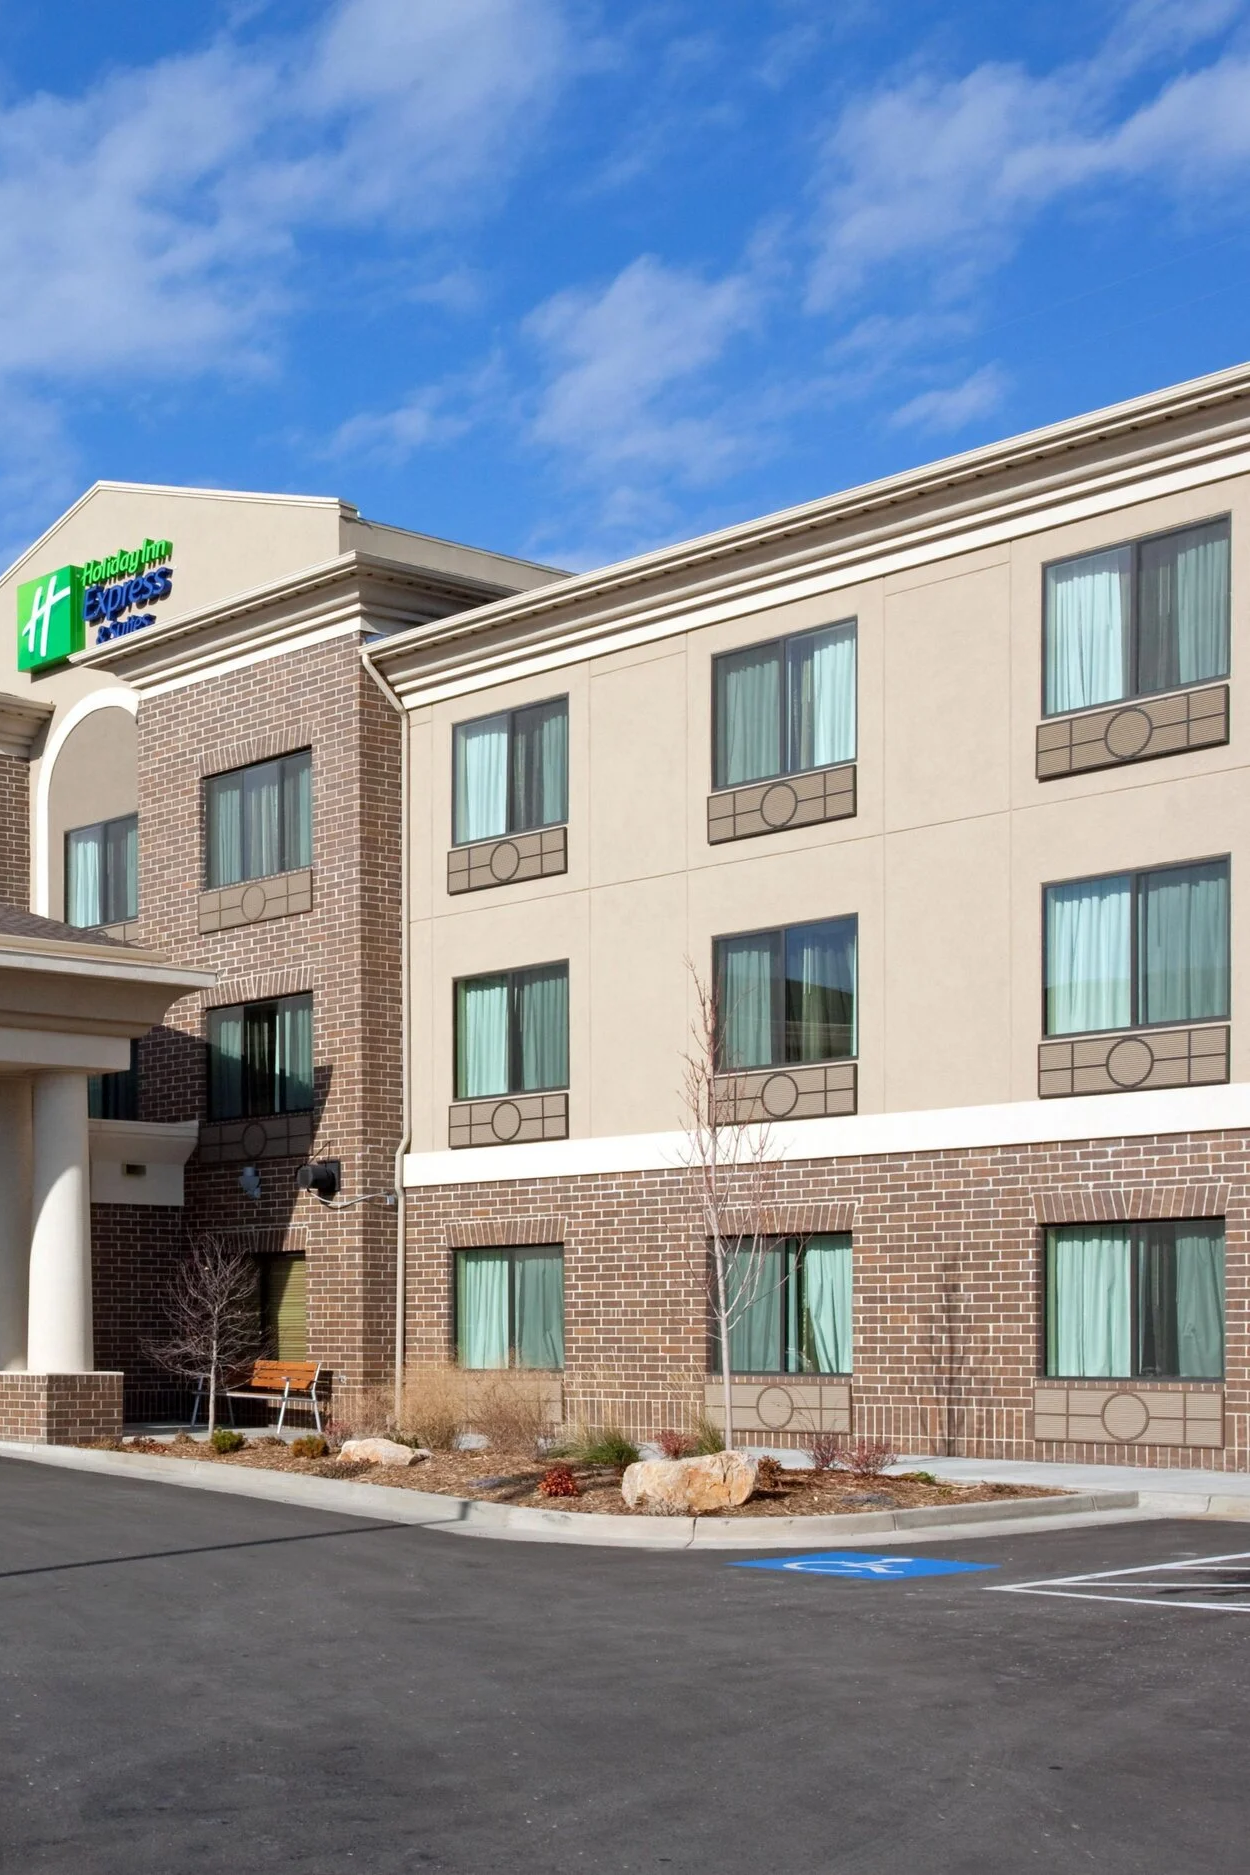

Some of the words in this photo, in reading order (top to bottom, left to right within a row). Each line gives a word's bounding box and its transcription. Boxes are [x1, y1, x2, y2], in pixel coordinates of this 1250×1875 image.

[82, 549, 140, 587] Holiday
[141, 537, 169, 564] Inn
[83, 567, 170, 622] Express
